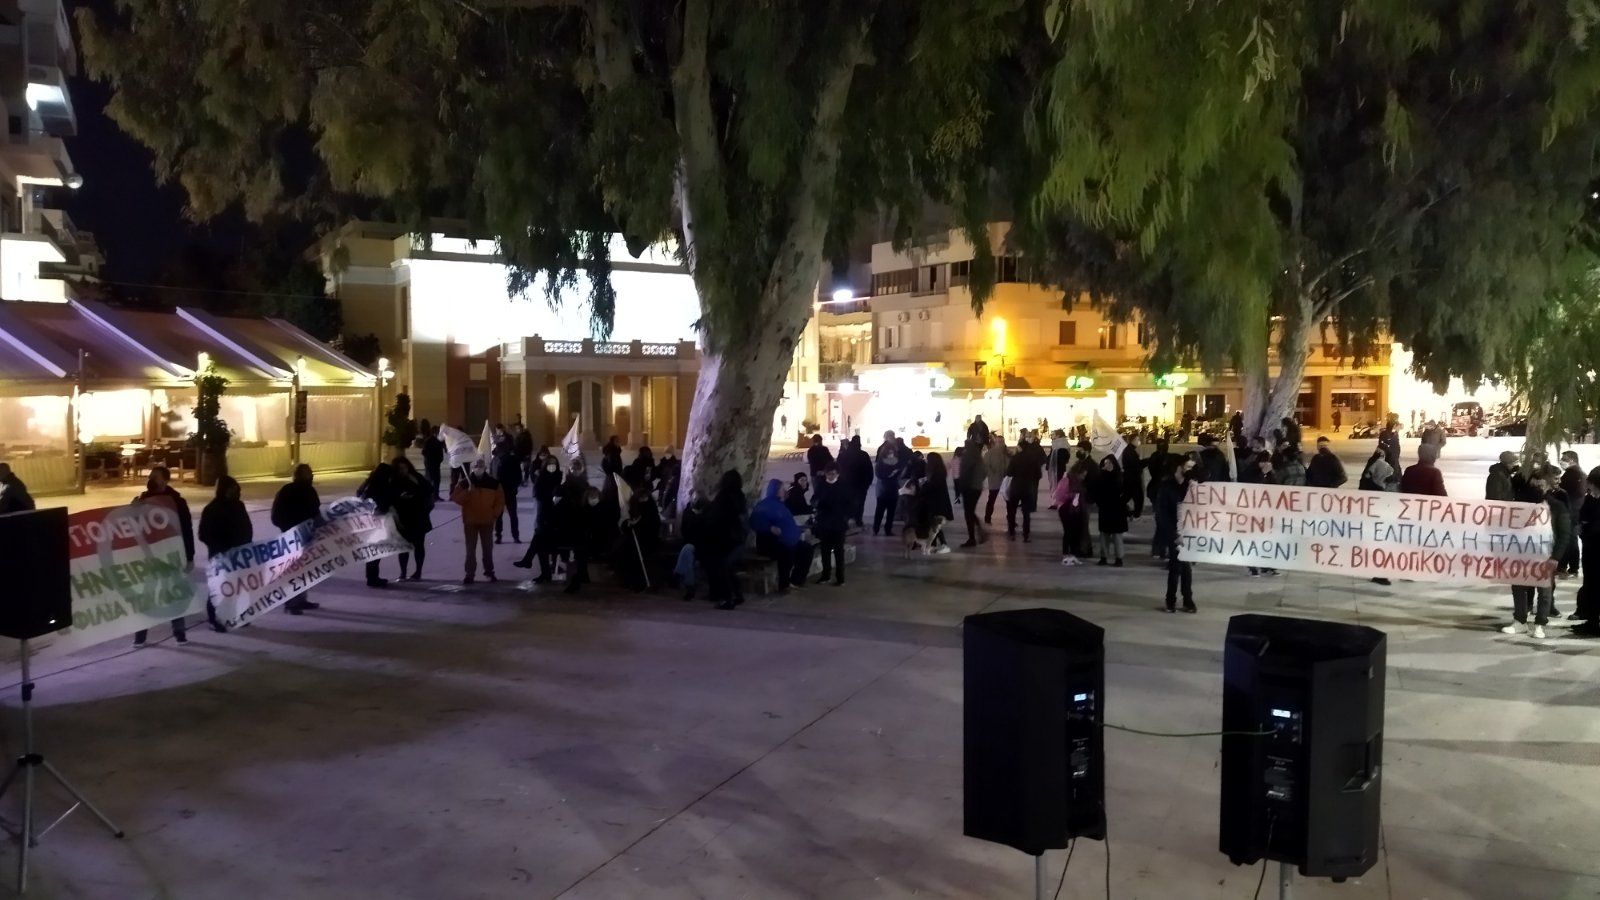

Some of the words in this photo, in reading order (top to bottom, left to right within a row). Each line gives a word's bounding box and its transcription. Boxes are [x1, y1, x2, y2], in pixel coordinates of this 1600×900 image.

[1182, 484, 1226, 506] ΔΕΝ
[1236, 487, 1381, 518] ΔΙΑΛΕΓΟΥΜΕ
[1182, 509, 1274, 534] ΛΗΣΤΩΝ!
[1281, 517, 1293, 534] Η
[1301, 518, 1363, 540] ΜΟΝΗ
[1374, 521, 1454, 548] ΕΛΠΙΔΑ
[1462, 530, 1478, 550] Η
[1182, 535, 1224, 553] ΤΩΝ
[1230, 539, 1298, 561] ΛΑΩΝ!
[1310, 543, 1343, 567] Φ.Σ.
[70, 566, 115, 599] ΗΝ
[220, 570, 265, 598] ΟΛΟΙ
[288, 554, 348, 593] ΣΥΛΛΟΓΟΙ
